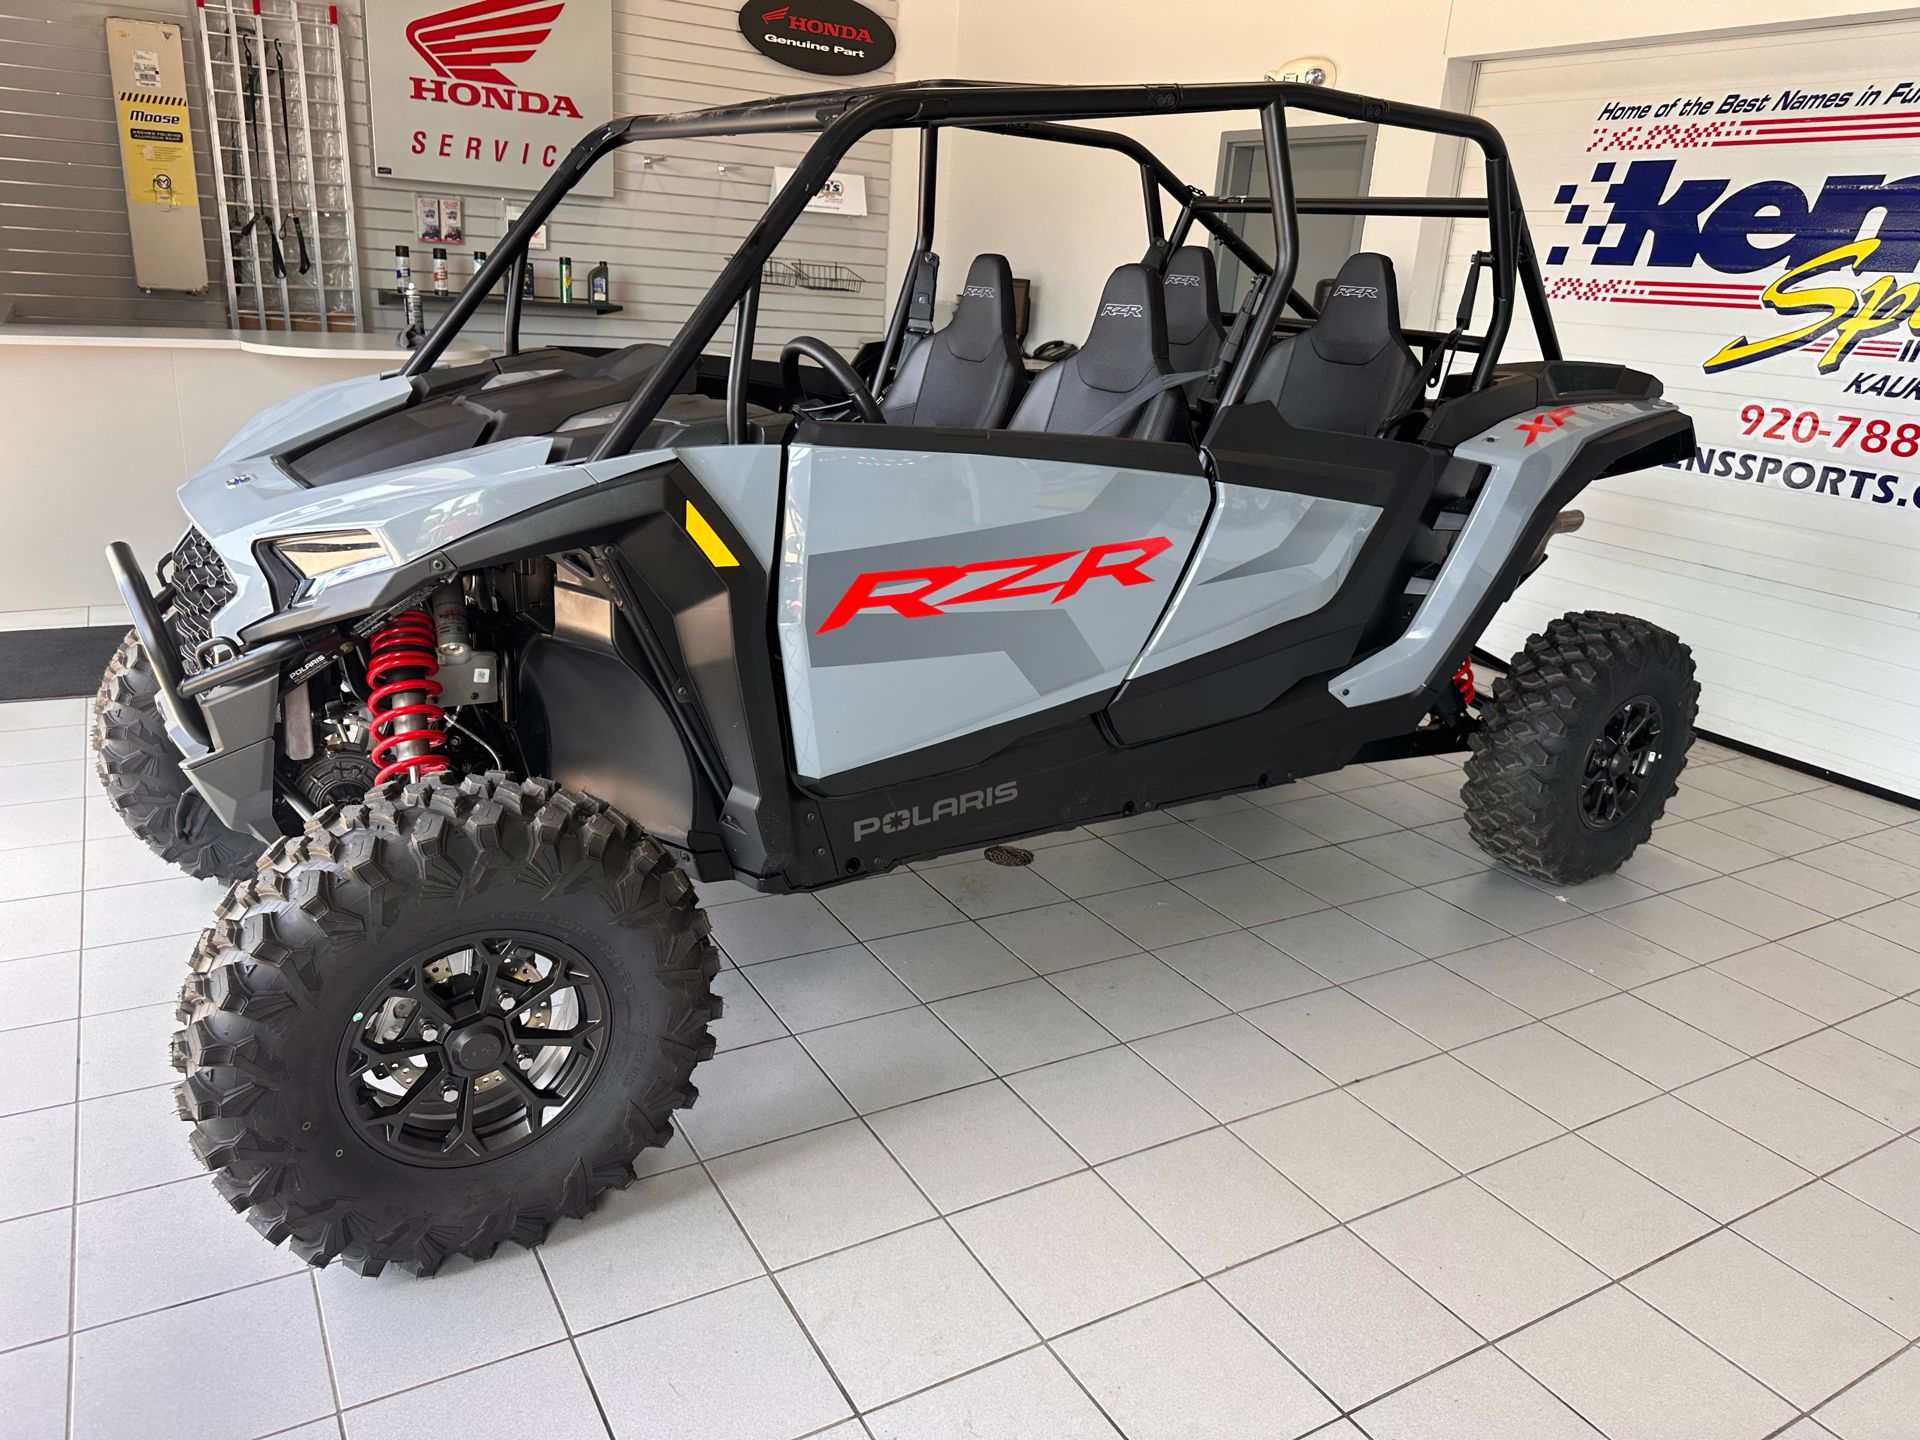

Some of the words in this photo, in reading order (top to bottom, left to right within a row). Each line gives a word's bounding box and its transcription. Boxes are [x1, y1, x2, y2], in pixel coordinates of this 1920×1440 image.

[788, 16, 874, 43] HONDA
[764, 33, 830, 52] Genuine
[834, 46, 865, 58] Part
[409, 77, 584, 119] HONDA
[1597, 102, 1652, 121] Home
[1654, 98, 1682, 118] of
[1678, 97, 1714, 116] the
[1715, 94, 1771, 114] Best
[1771, 90, 1854, 111] Names
[1855, 85, 1882, 106] in
[130, 110, 180, 124] Moose
[411, 131, 557, 167] SERVIC
[963, 285, 994, 298] RZR
[1164, 274, 1201, 287] RZR
[1333, 285, 1378, 298] RZR
[1100, 303, 1143, 318] RZR
[1740, 404, 1920, 457] 920-788
[814, 536, 1173, 635] RZR
[289, 654, 326, 680] POLARIS
[853, 780, 1018, 843] POLARIS
